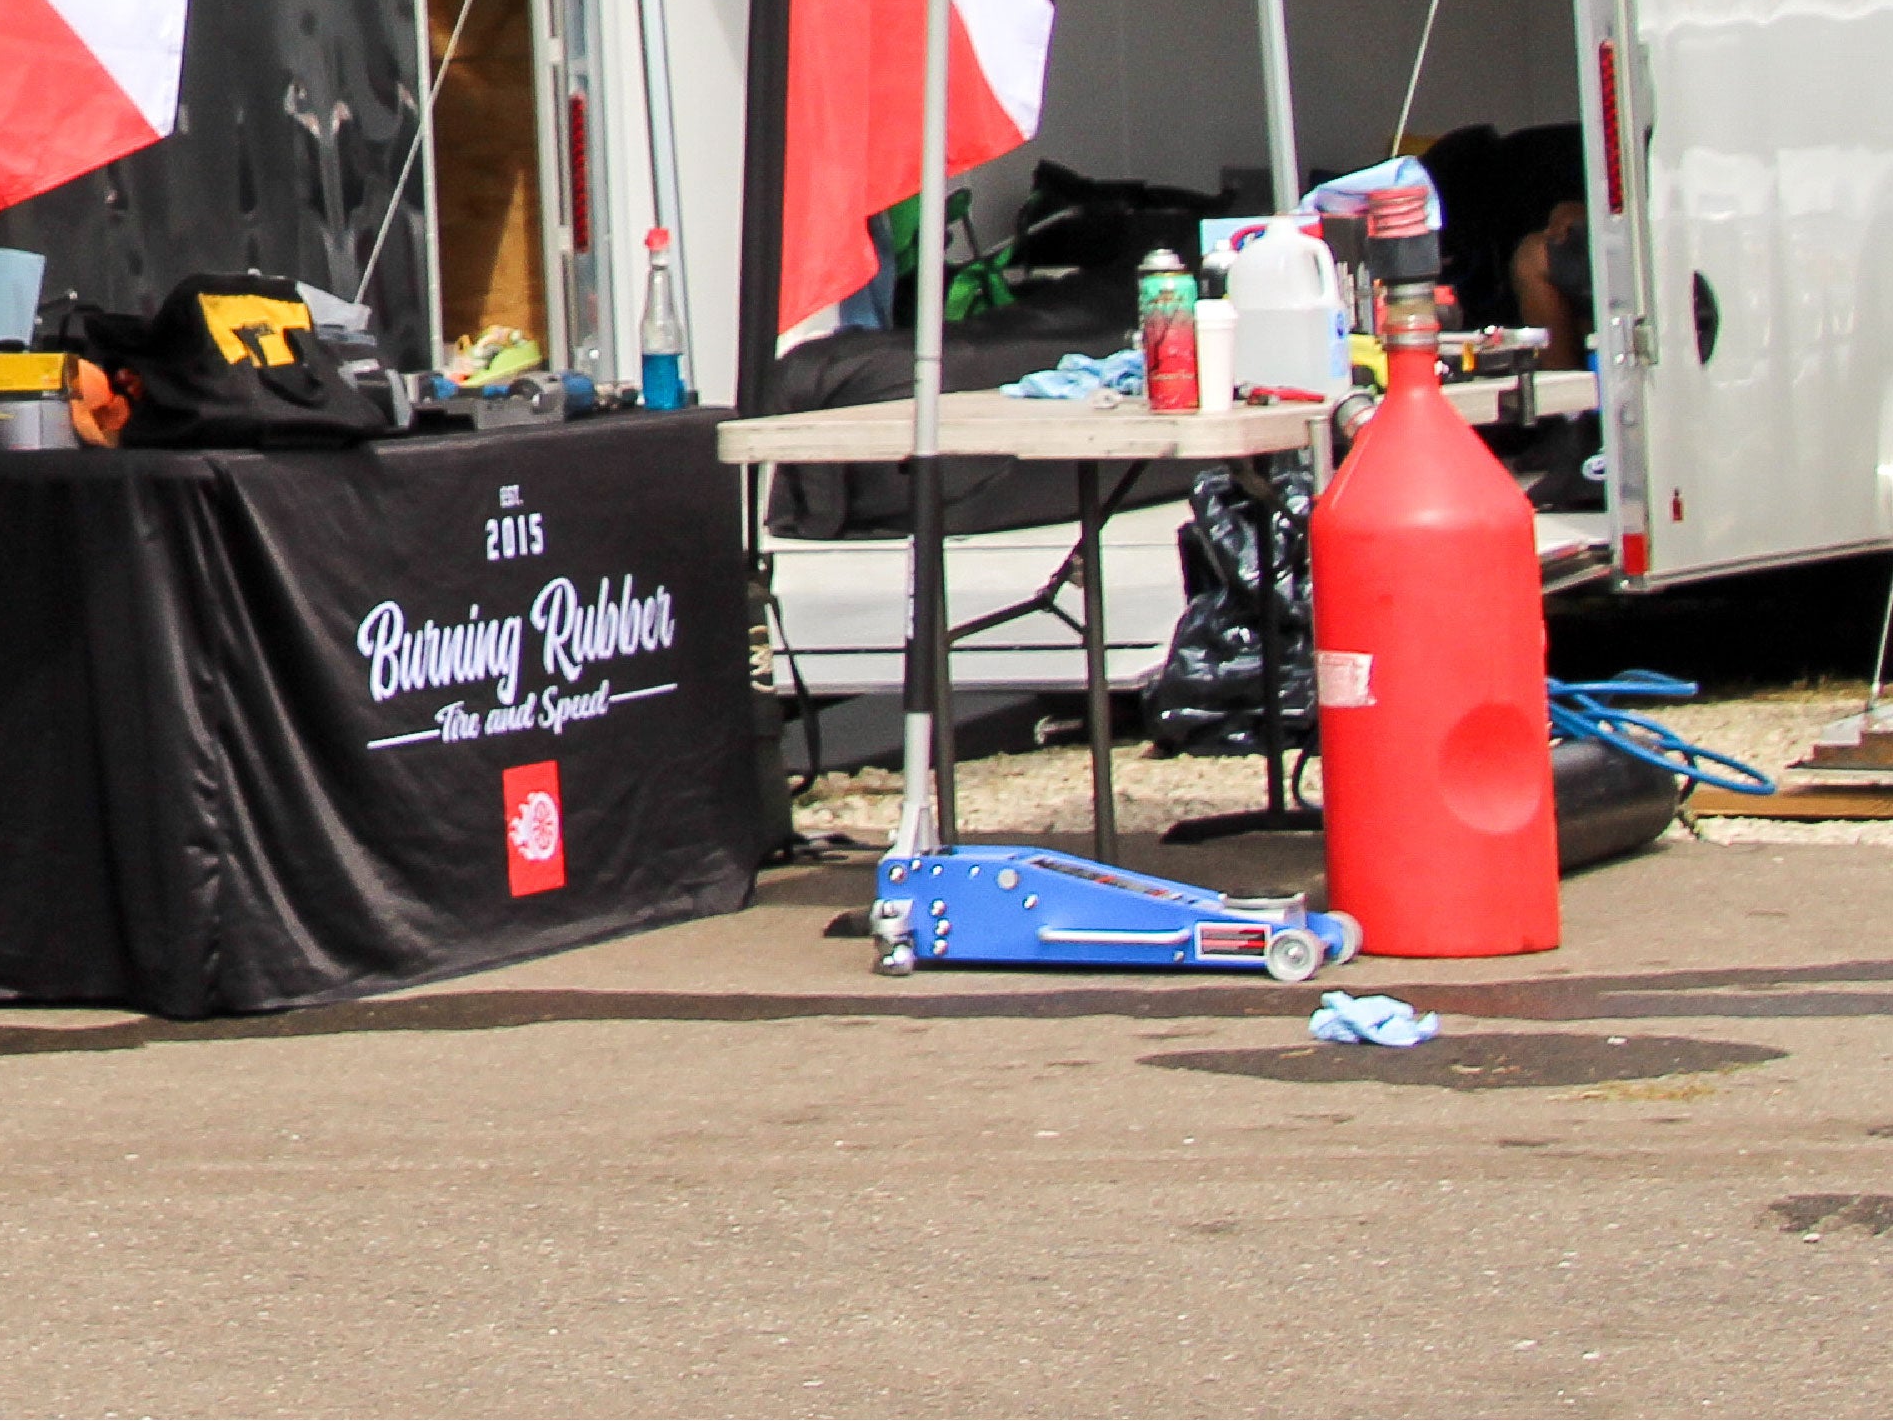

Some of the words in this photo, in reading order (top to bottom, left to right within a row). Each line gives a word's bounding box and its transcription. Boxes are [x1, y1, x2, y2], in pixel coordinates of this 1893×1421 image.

[485, 512, 545, 561] 2015
[357, 600, 523, 706] Burning
[530, 573, 675, 682] Rubber
[435, 700, 481, 743] Tire
[484, 691, 537, 736] and
[538, 679, 610, 736] Speed
